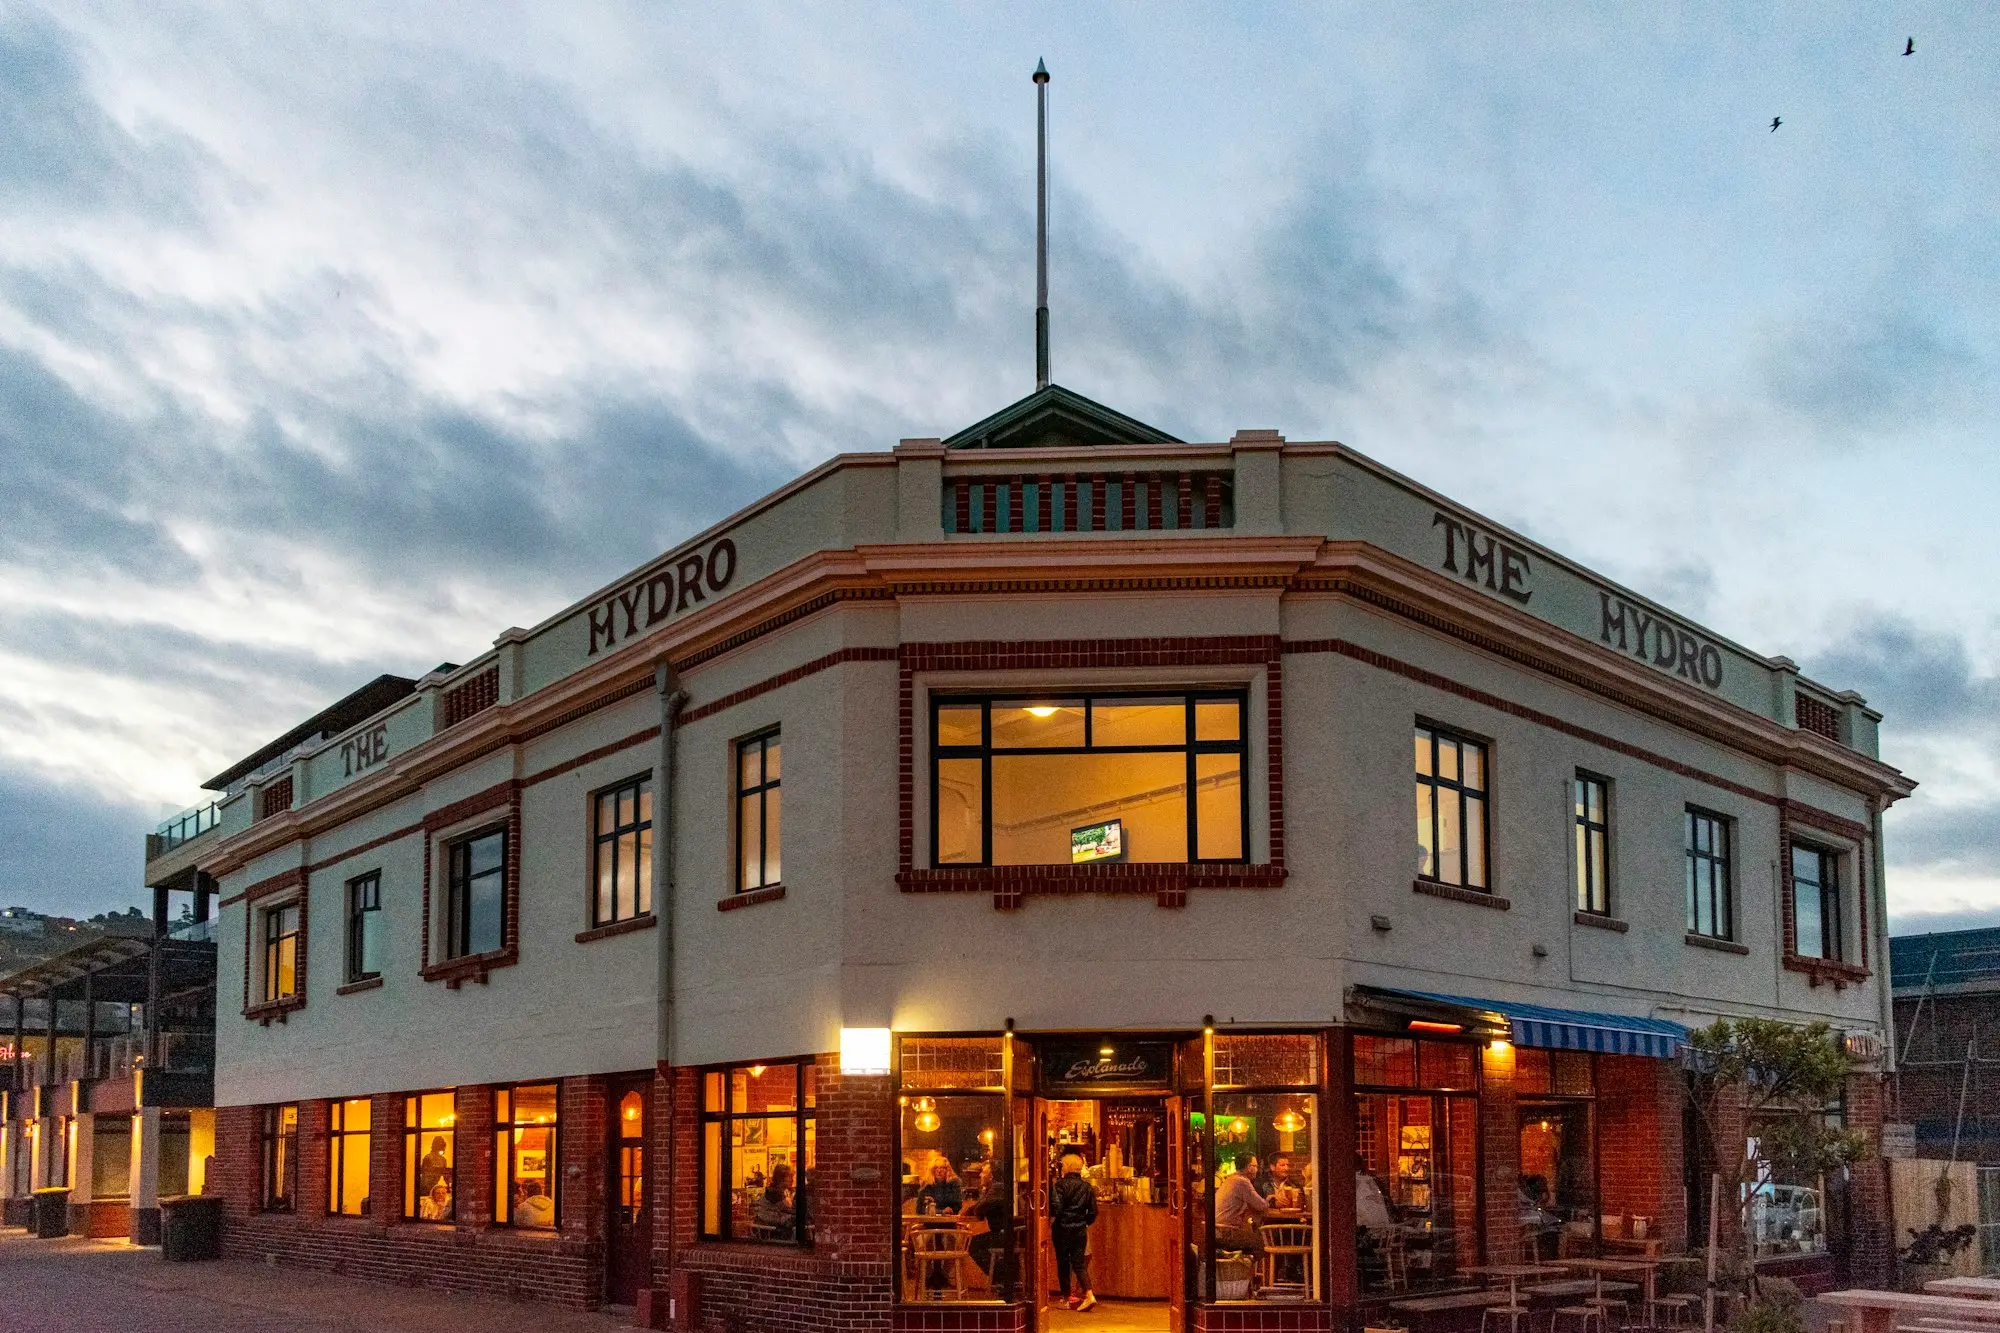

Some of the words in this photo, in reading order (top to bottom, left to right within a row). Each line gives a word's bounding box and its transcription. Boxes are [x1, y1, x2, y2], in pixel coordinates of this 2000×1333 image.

[341, 723, 389, 777] THE
[588, 538, 737, 656] HYDRO
[1432, 512, 1532, 605] THE
[1599, 591, 1722, 689] HYDRO
[1065, 1056, 1146, 1079] Esplanade
